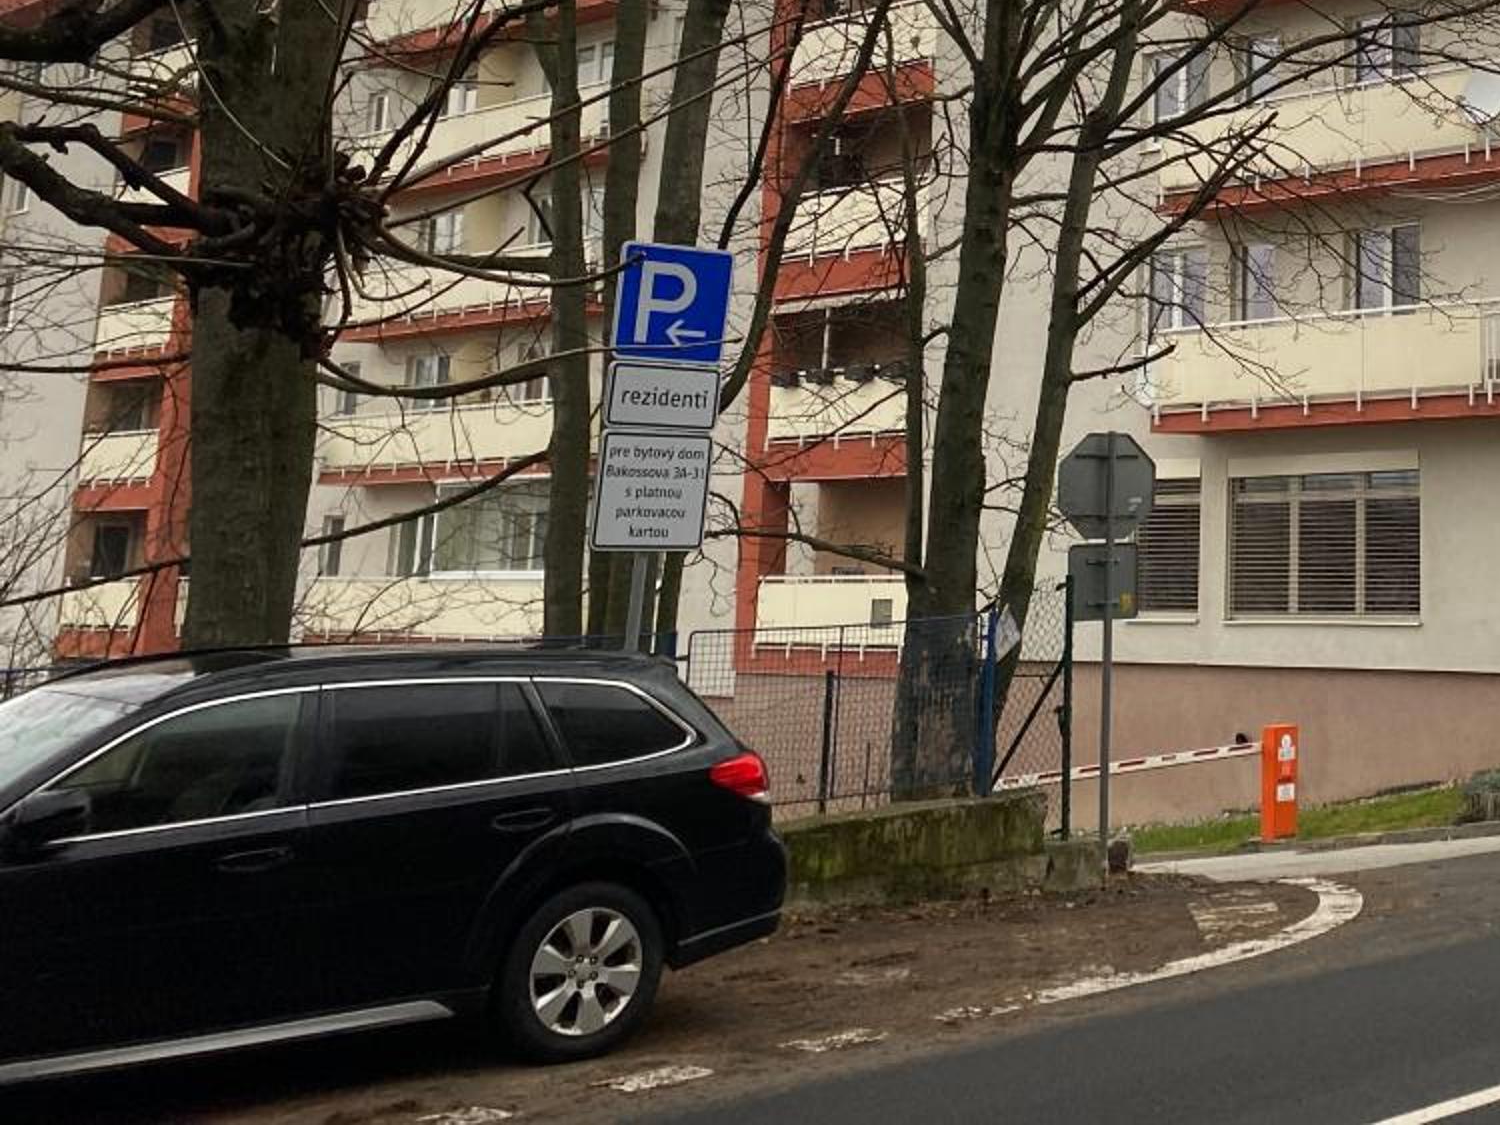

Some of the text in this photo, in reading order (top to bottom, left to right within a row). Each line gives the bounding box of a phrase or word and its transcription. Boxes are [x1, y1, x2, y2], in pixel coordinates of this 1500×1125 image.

[633, 261, 698, 344] P
[621, 387, 708, 409] rezidenti
[609, 447, 631, 460] pre
[678, 447, 705, 460] dom
[624, 485, 683, 500] s platnou
[628, 524, 669, 538] kartou
